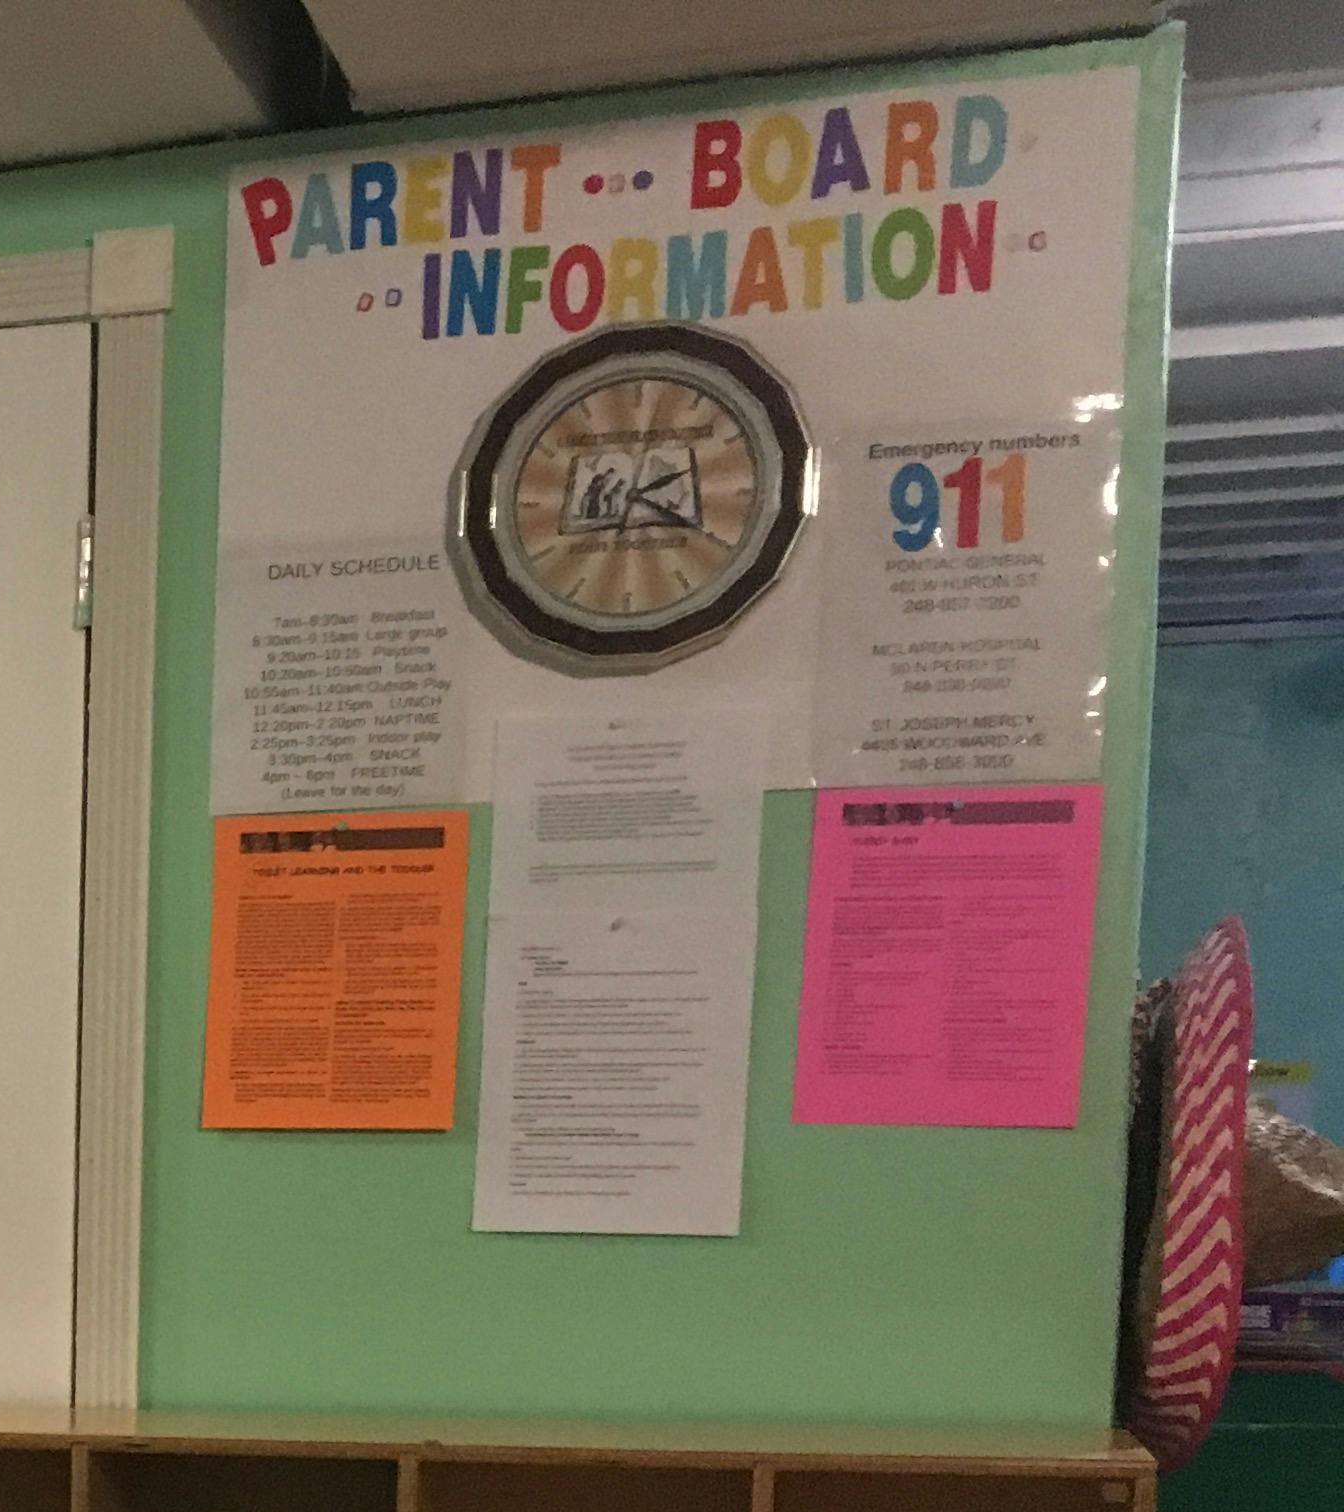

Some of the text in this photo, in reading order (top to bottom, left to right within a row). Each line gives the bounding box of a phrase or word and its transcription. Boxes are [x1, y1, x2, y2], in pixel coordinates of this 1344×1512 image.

[241, 94, 1009, 266] PARENT BOARD
[421, 201, 998, 340] INFORMATION
[868, 433, 1081, 461] Emergency numbers
[889, 452, 1027, 552] 911
[268, 555, 441, 580] DAILY SCHEDULE
[375, 711, 441, 727] NAPTIME
[369, 747, 422, 762] SNACK
[330, 783, 348, 798] for
[352, 783, 372, 798] the
[375, 781, 406, 799] day)
